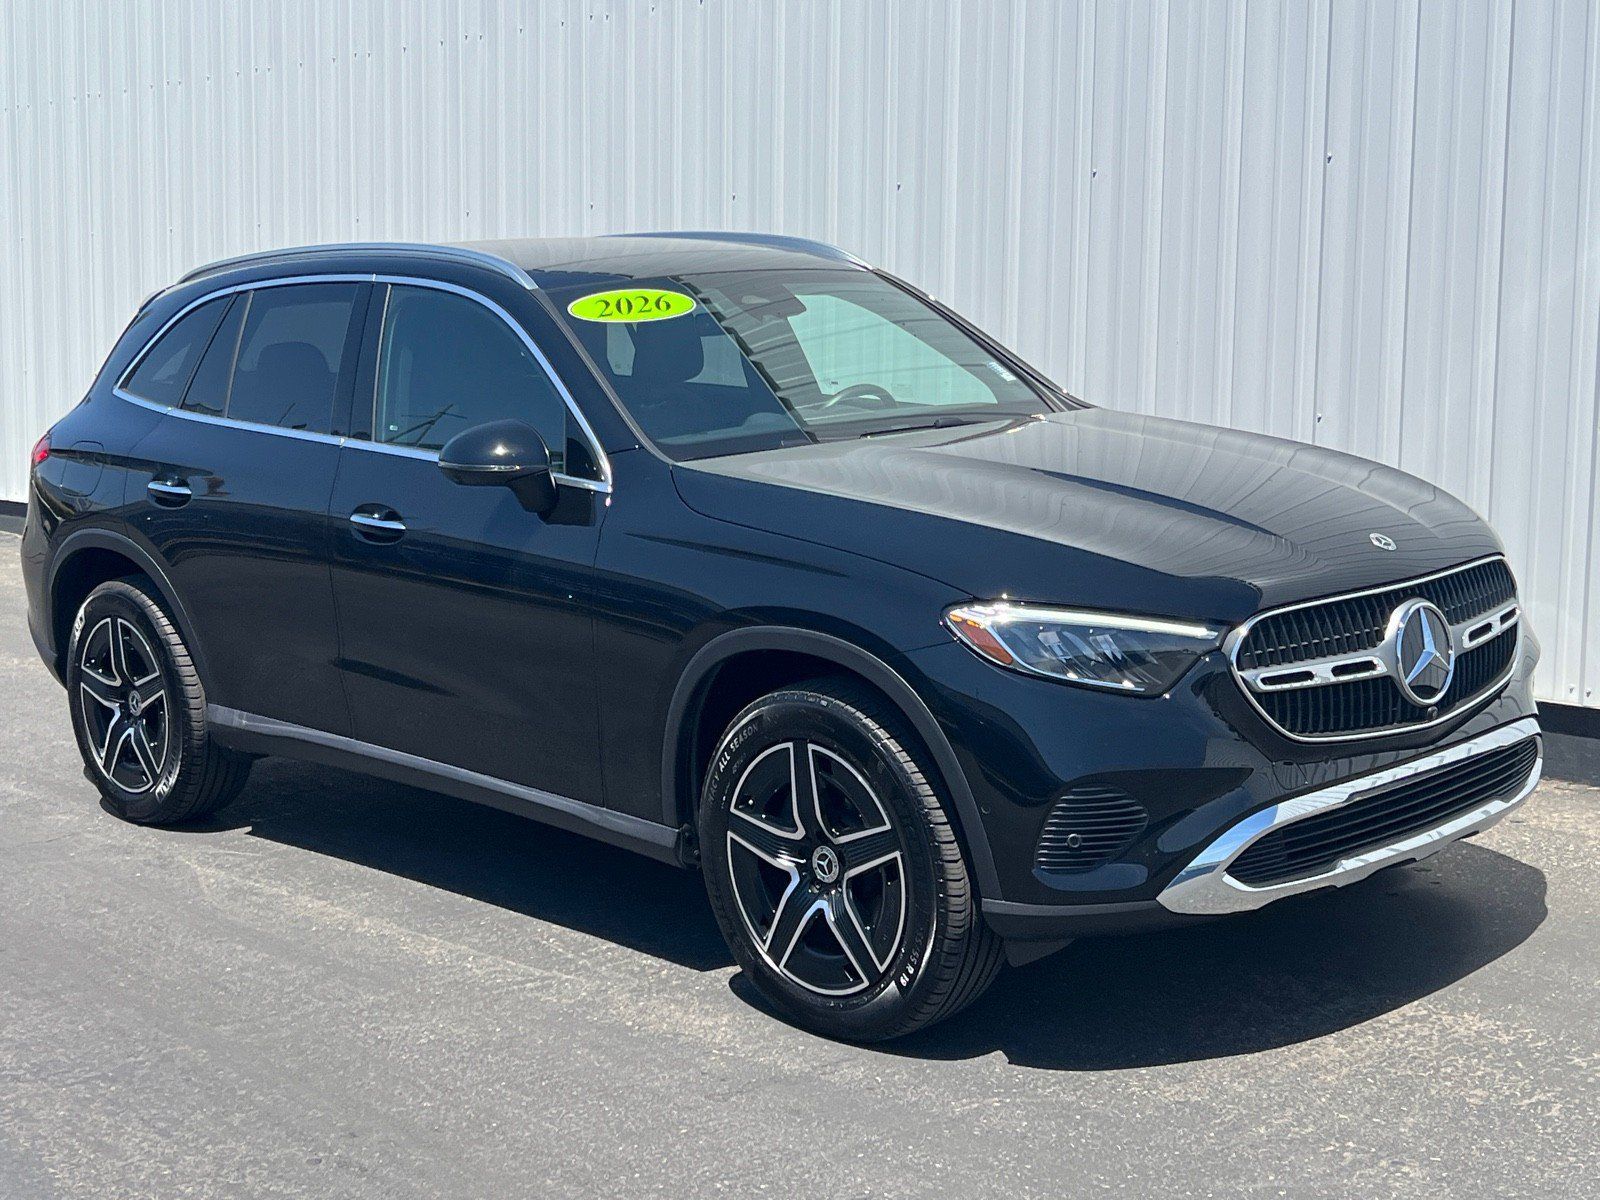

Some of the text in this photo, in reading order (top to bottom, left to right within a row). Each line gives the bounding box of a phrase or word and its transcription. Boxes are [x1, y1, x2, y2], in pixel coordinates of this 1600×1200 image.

[595, 294, 672, 318] 2026
[718, 751, 731, 773] ALL
[729, 723, 759, 752] SEASON
